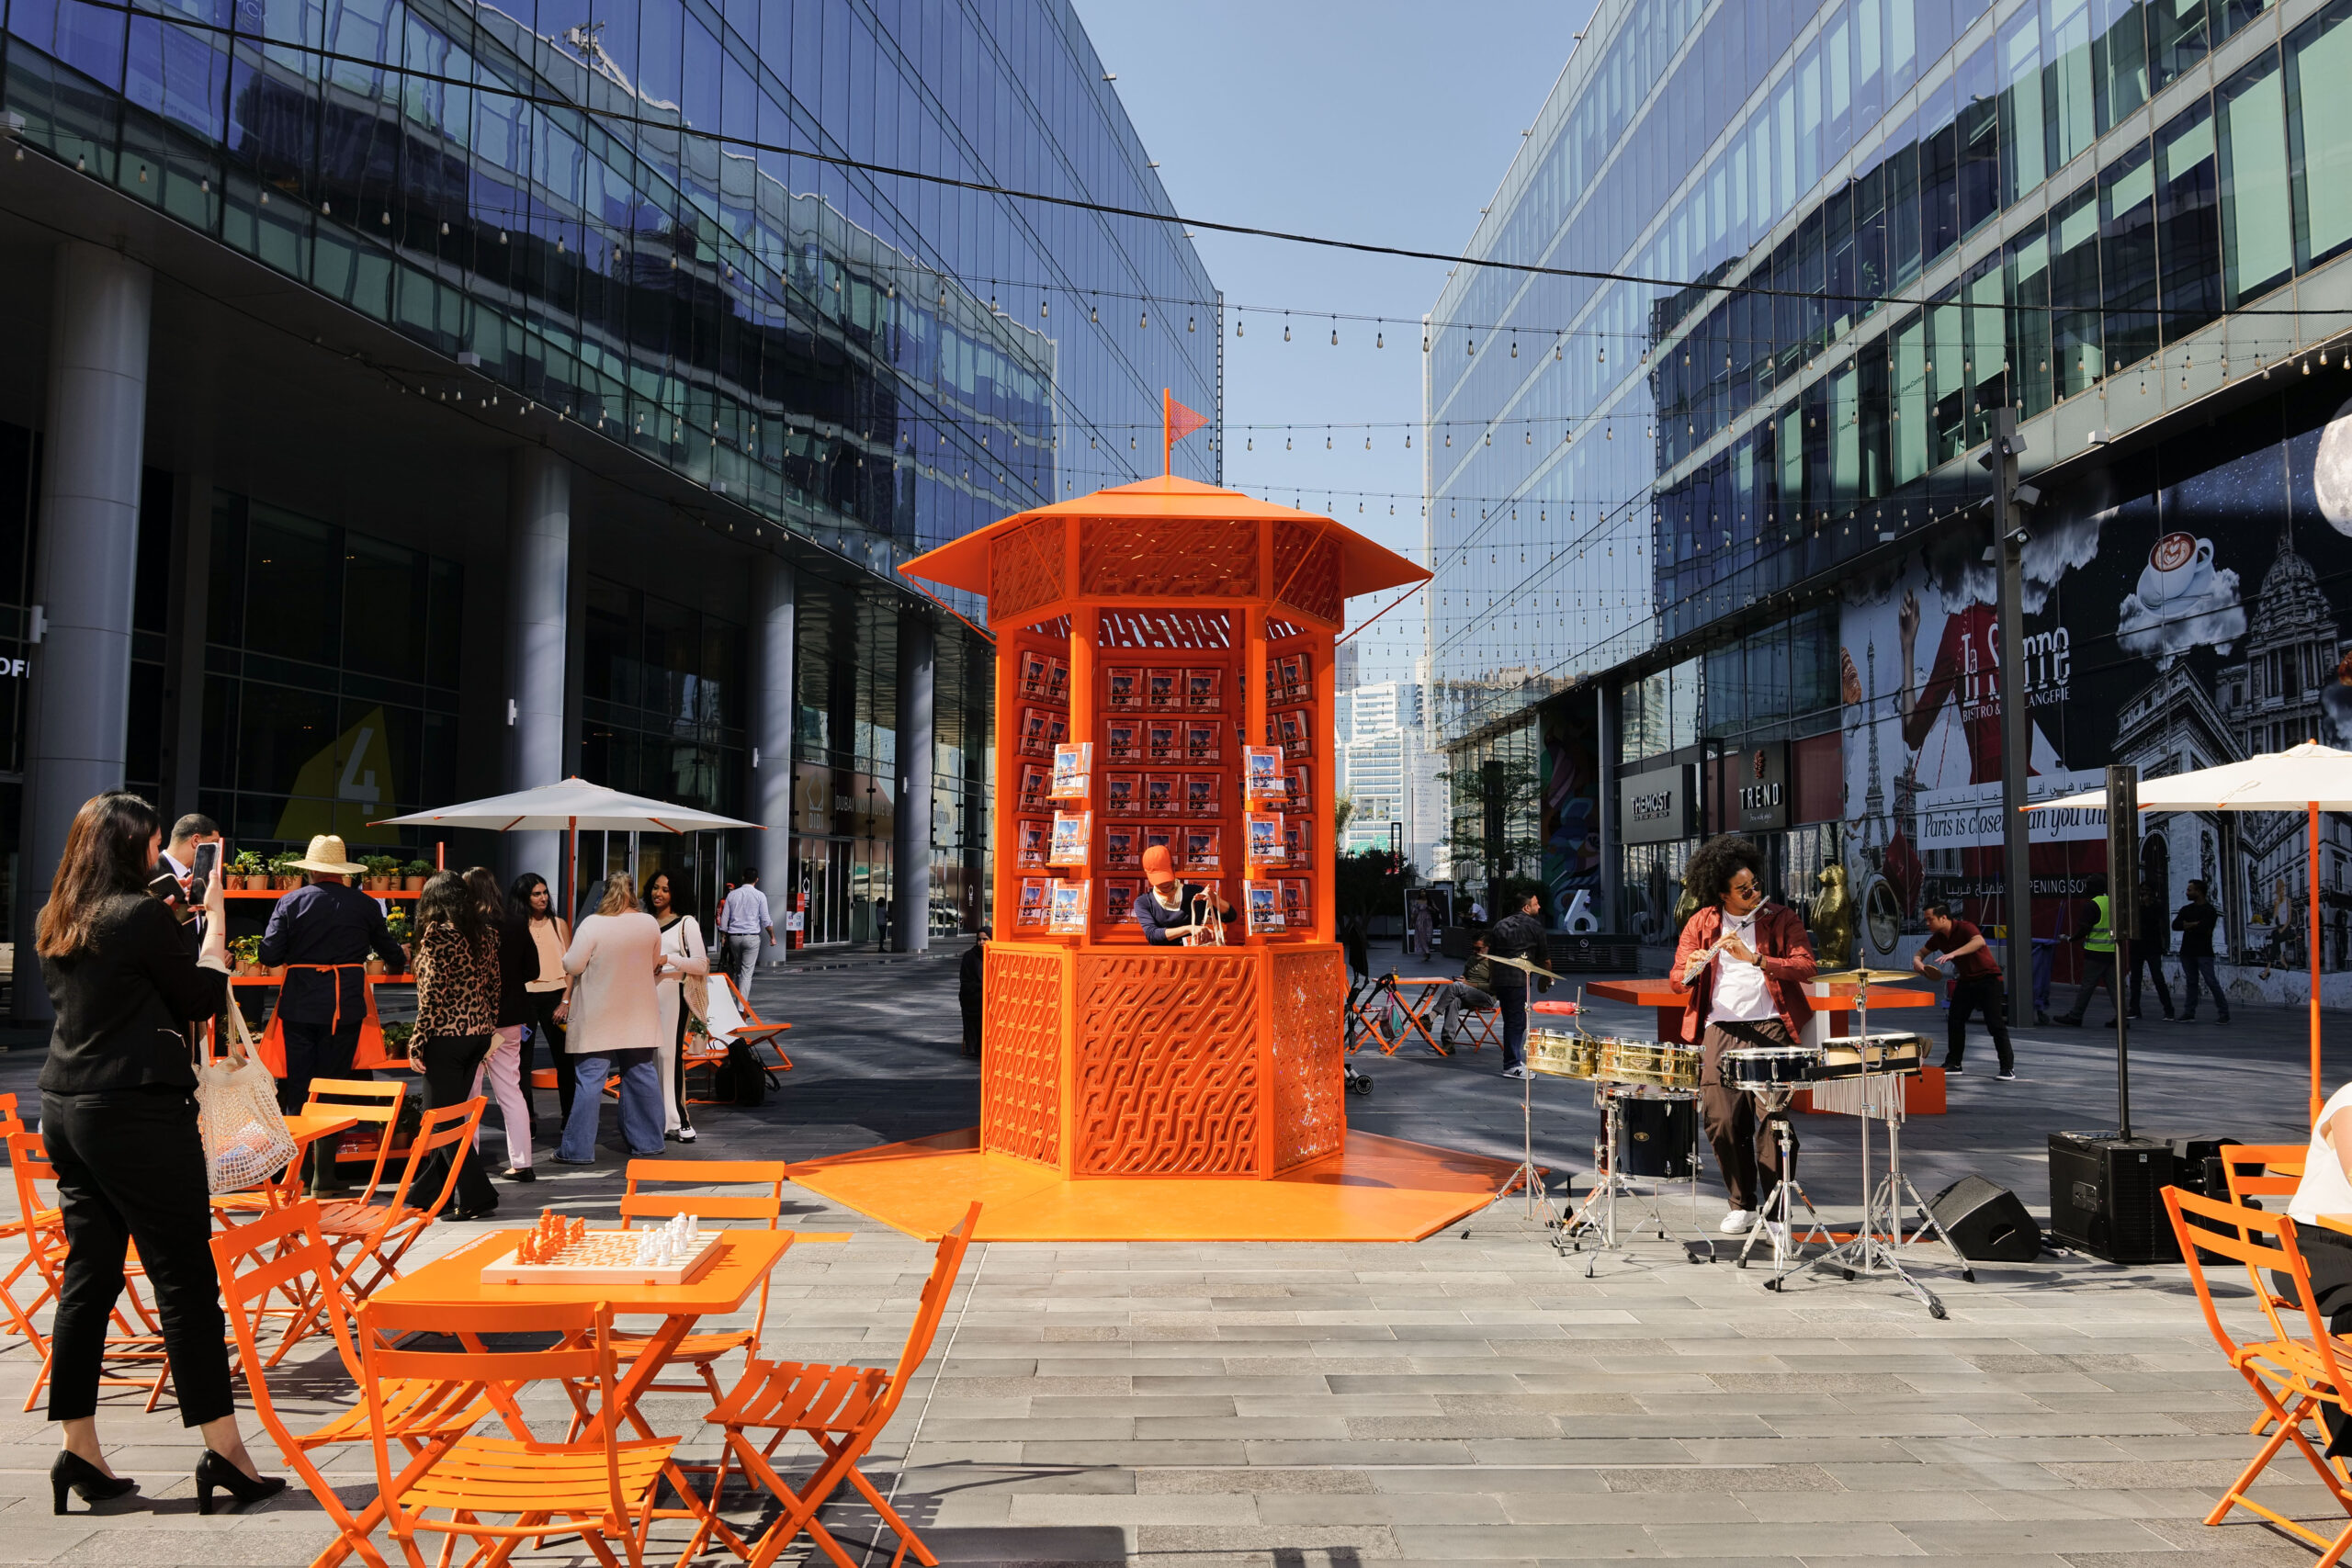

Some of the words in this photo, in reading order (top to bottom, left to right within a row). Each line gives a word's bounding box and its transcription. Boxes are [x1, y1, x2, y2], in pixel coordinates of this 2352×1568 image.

[0, 657, 30, 679] OF
[1987, 623, 2071, 702] Srre
[1962, 704, 1994, 723] BISTRO
[2025, 686, 2071, 709] ANGERIE
[338, 727, 379, 816] 4
[836, 795, 854, 813] DUBAI
[1739, 783, 1779, 810] TREND
[808, 812, 824, 830] DIDI
[1925, 813, 1952, 838] Paris
[1956, 810, 1966, 836] is
[1969, 808, 2005, 835] close
[2030, 879, 2066, 894] PENING
[1564, 889, 1599, 935] 6
